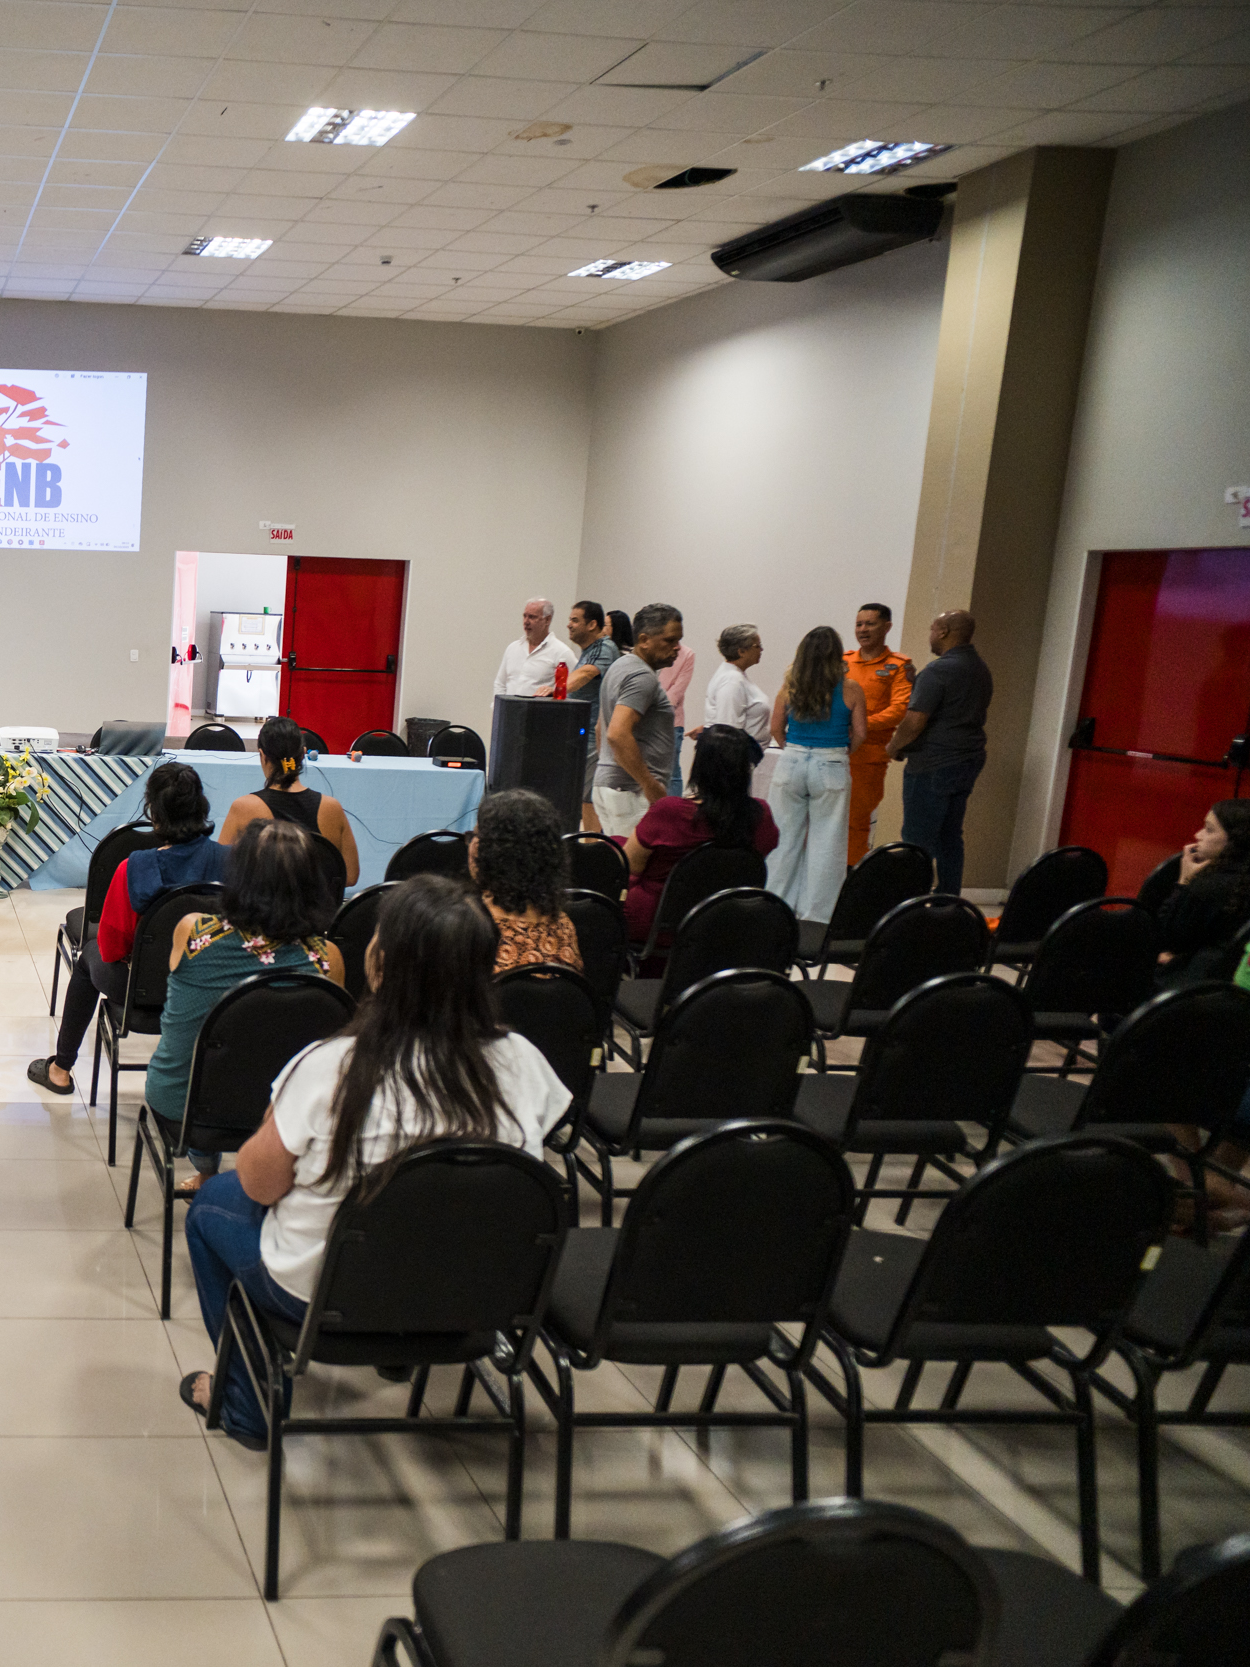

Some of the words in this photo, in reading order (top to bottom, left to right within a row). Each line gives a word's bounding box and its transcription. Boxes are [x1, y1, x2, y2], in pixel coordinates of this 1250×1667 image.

[34, 513, 51, 522] DE
[54, 513, 99, 524] ENSINO
[270, 529, 294, 540] SAÍDA
